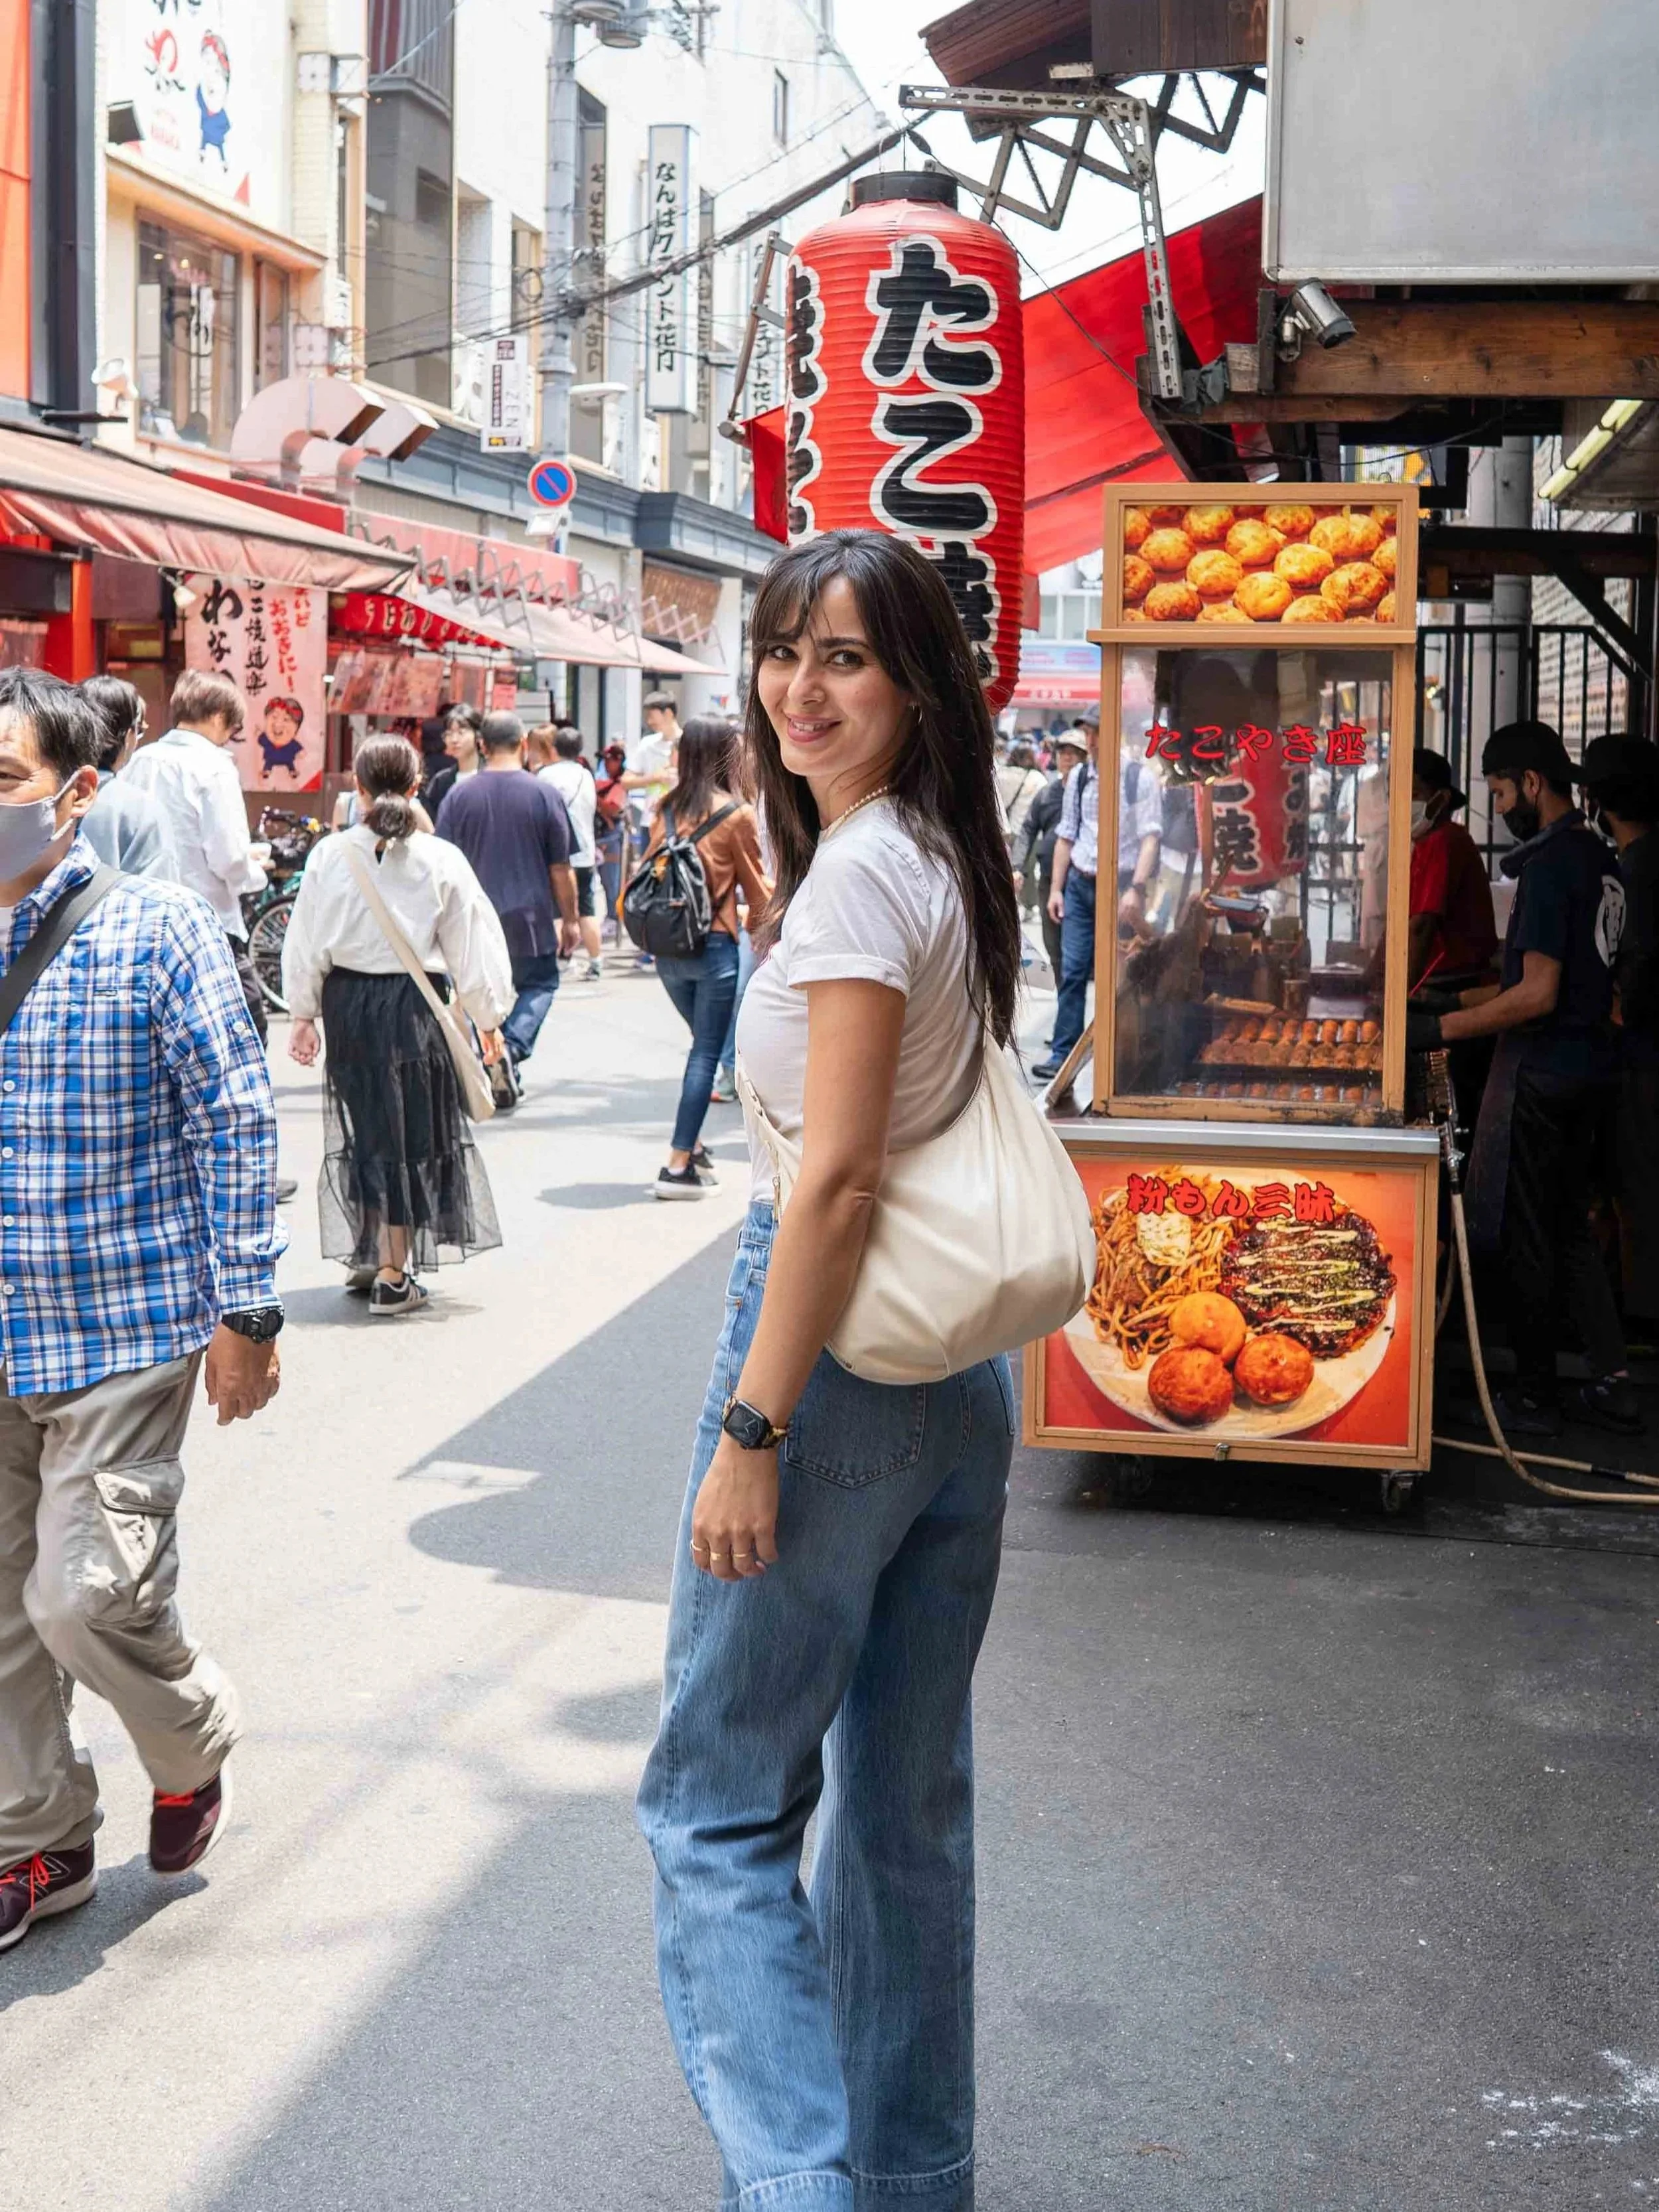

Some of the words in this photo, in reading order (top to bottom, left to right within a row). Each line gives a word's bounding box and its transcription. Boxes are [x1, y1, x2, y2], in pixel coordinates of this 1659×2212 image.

[1145, 721, 1367, 766] たこやき座
[1126, 1173, 1335, 1222] 粉もん三昧
